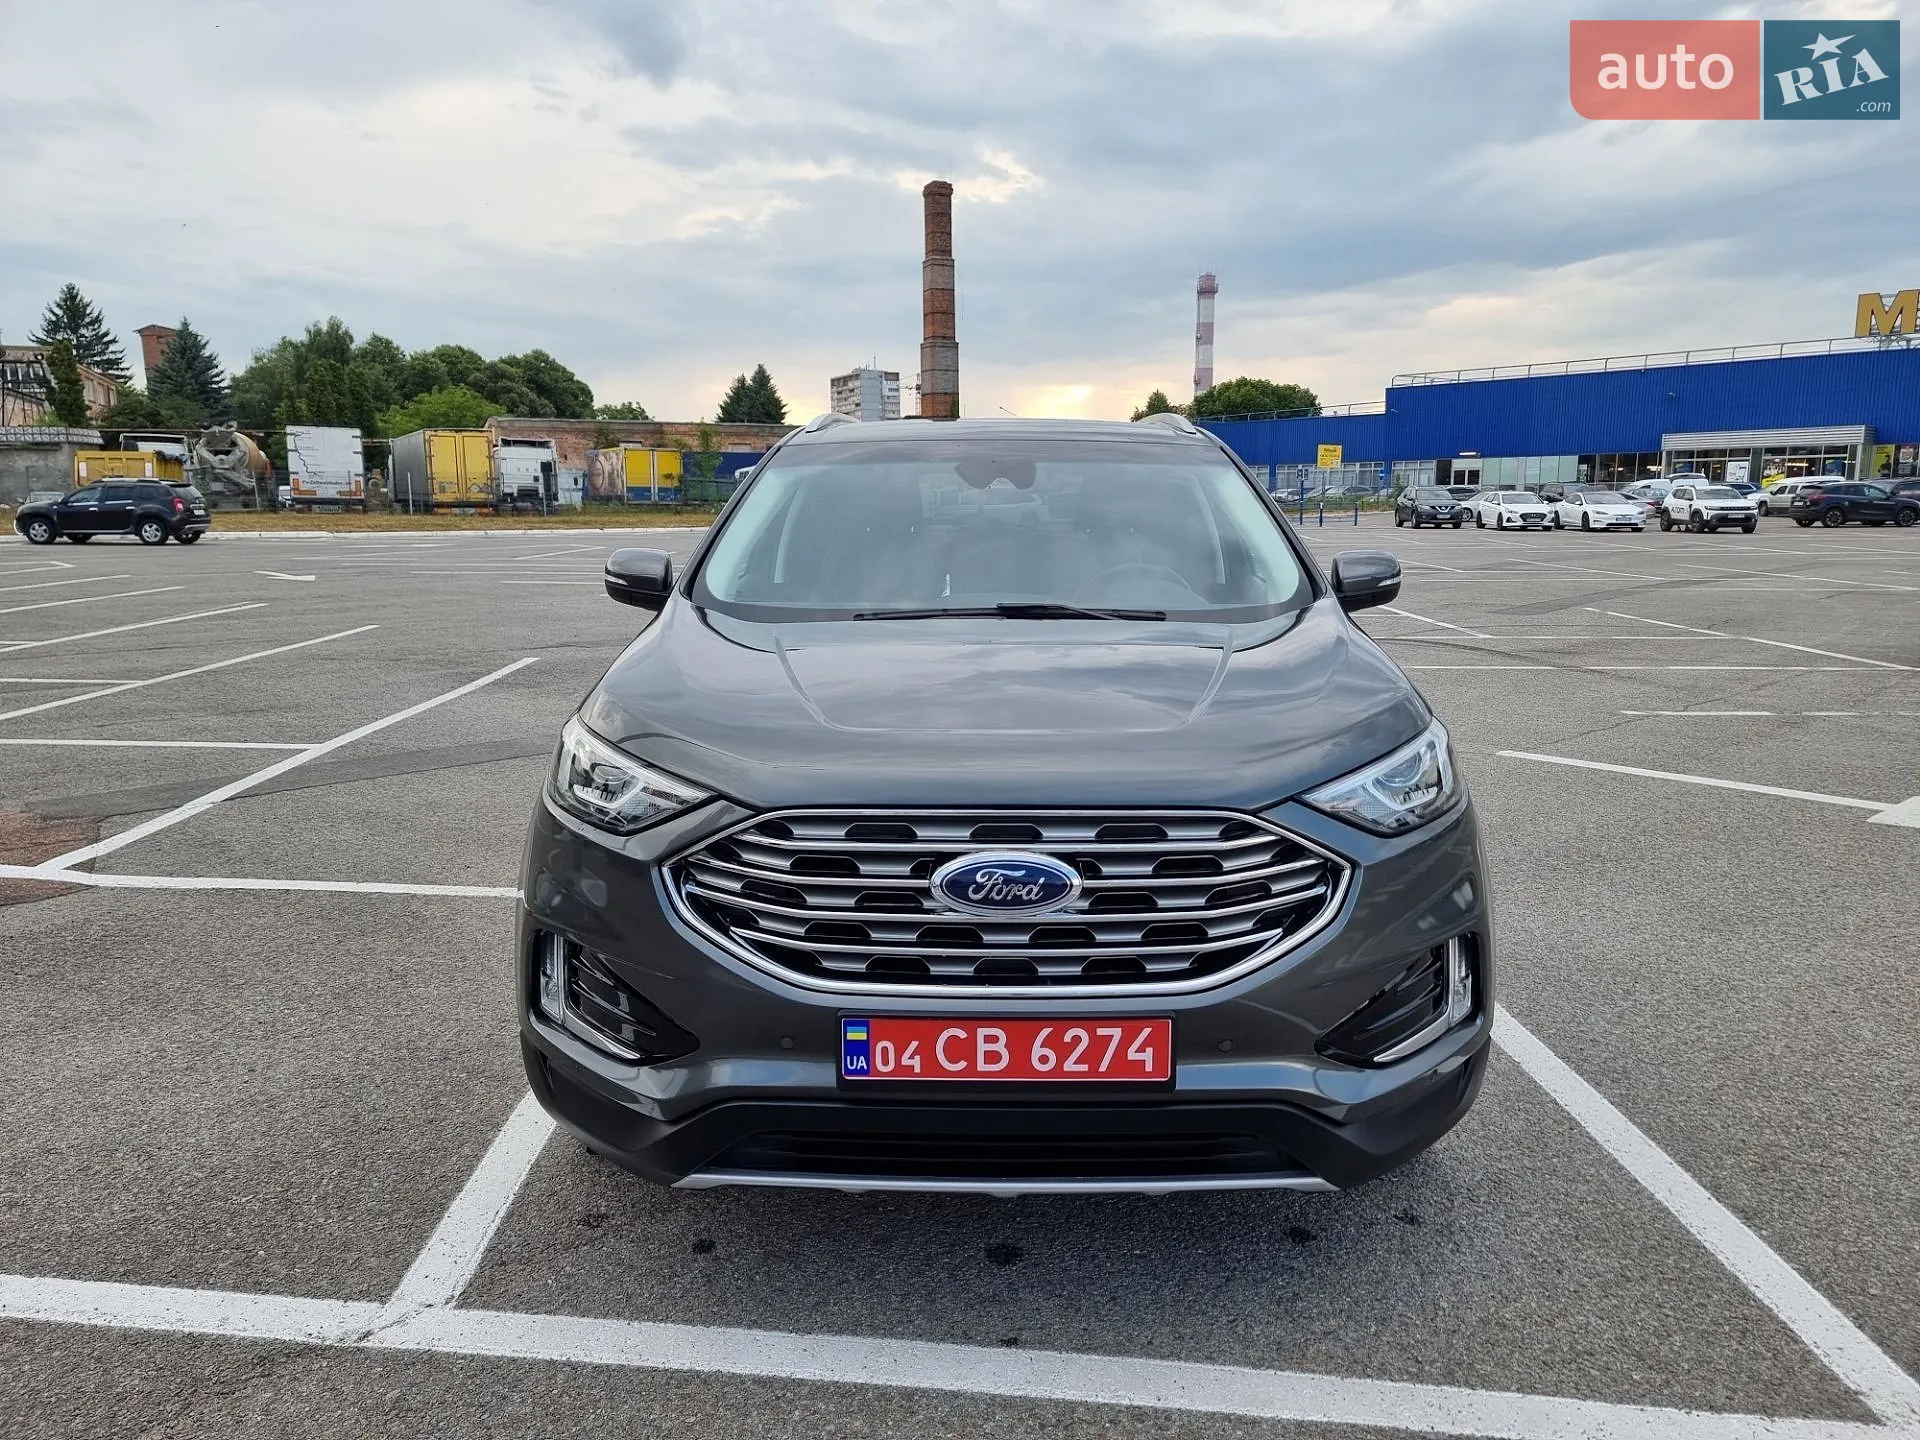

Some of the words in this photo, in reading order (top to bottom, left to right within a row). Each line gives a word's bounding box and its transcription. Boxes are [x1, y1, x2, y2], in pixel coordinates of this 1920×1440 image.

[1855, 288, 1920, 338] M
[967, 868, 1046, 901] Ford
[846, 1055, 868, 1070] UA
[875, 1040, 921, 1073] 04
[935, 1027, 1010, 1072] CB
[1030, 1027, 1154, 1073] 6274
